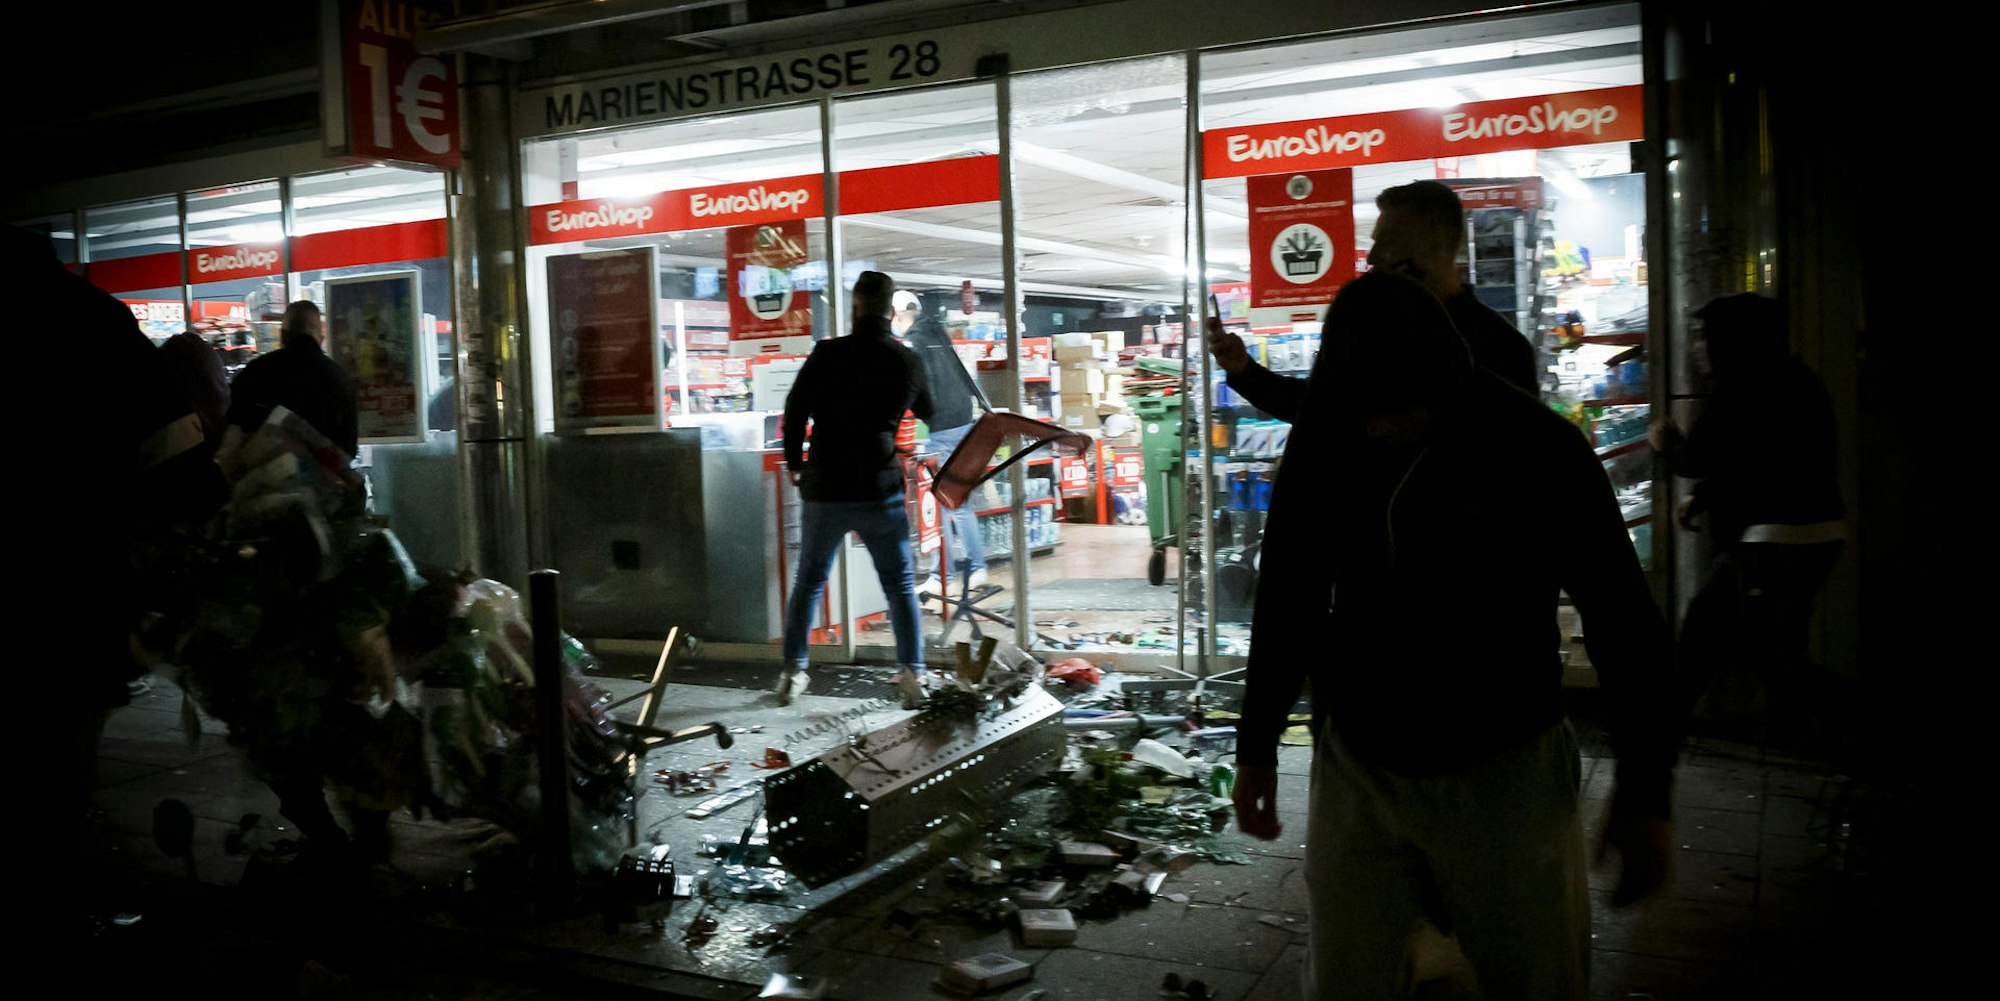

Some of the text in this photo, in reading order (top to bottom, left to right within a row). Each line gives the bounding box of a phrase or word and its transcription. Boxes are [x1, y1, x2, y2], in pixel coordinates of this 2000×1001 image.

[358, 42, 450, 154] 1€
[545, 40, 941, 129] MARIENSTRASSE 28
[1441, 101, 1619, 143] EuroShop
[1227, 125, 1386, 163] EuroShop
[546, 203, 654, 233] EuroShop
[689, 185, 810, 218] EuroShop
[196, 247, 279, 273] EuroShop
